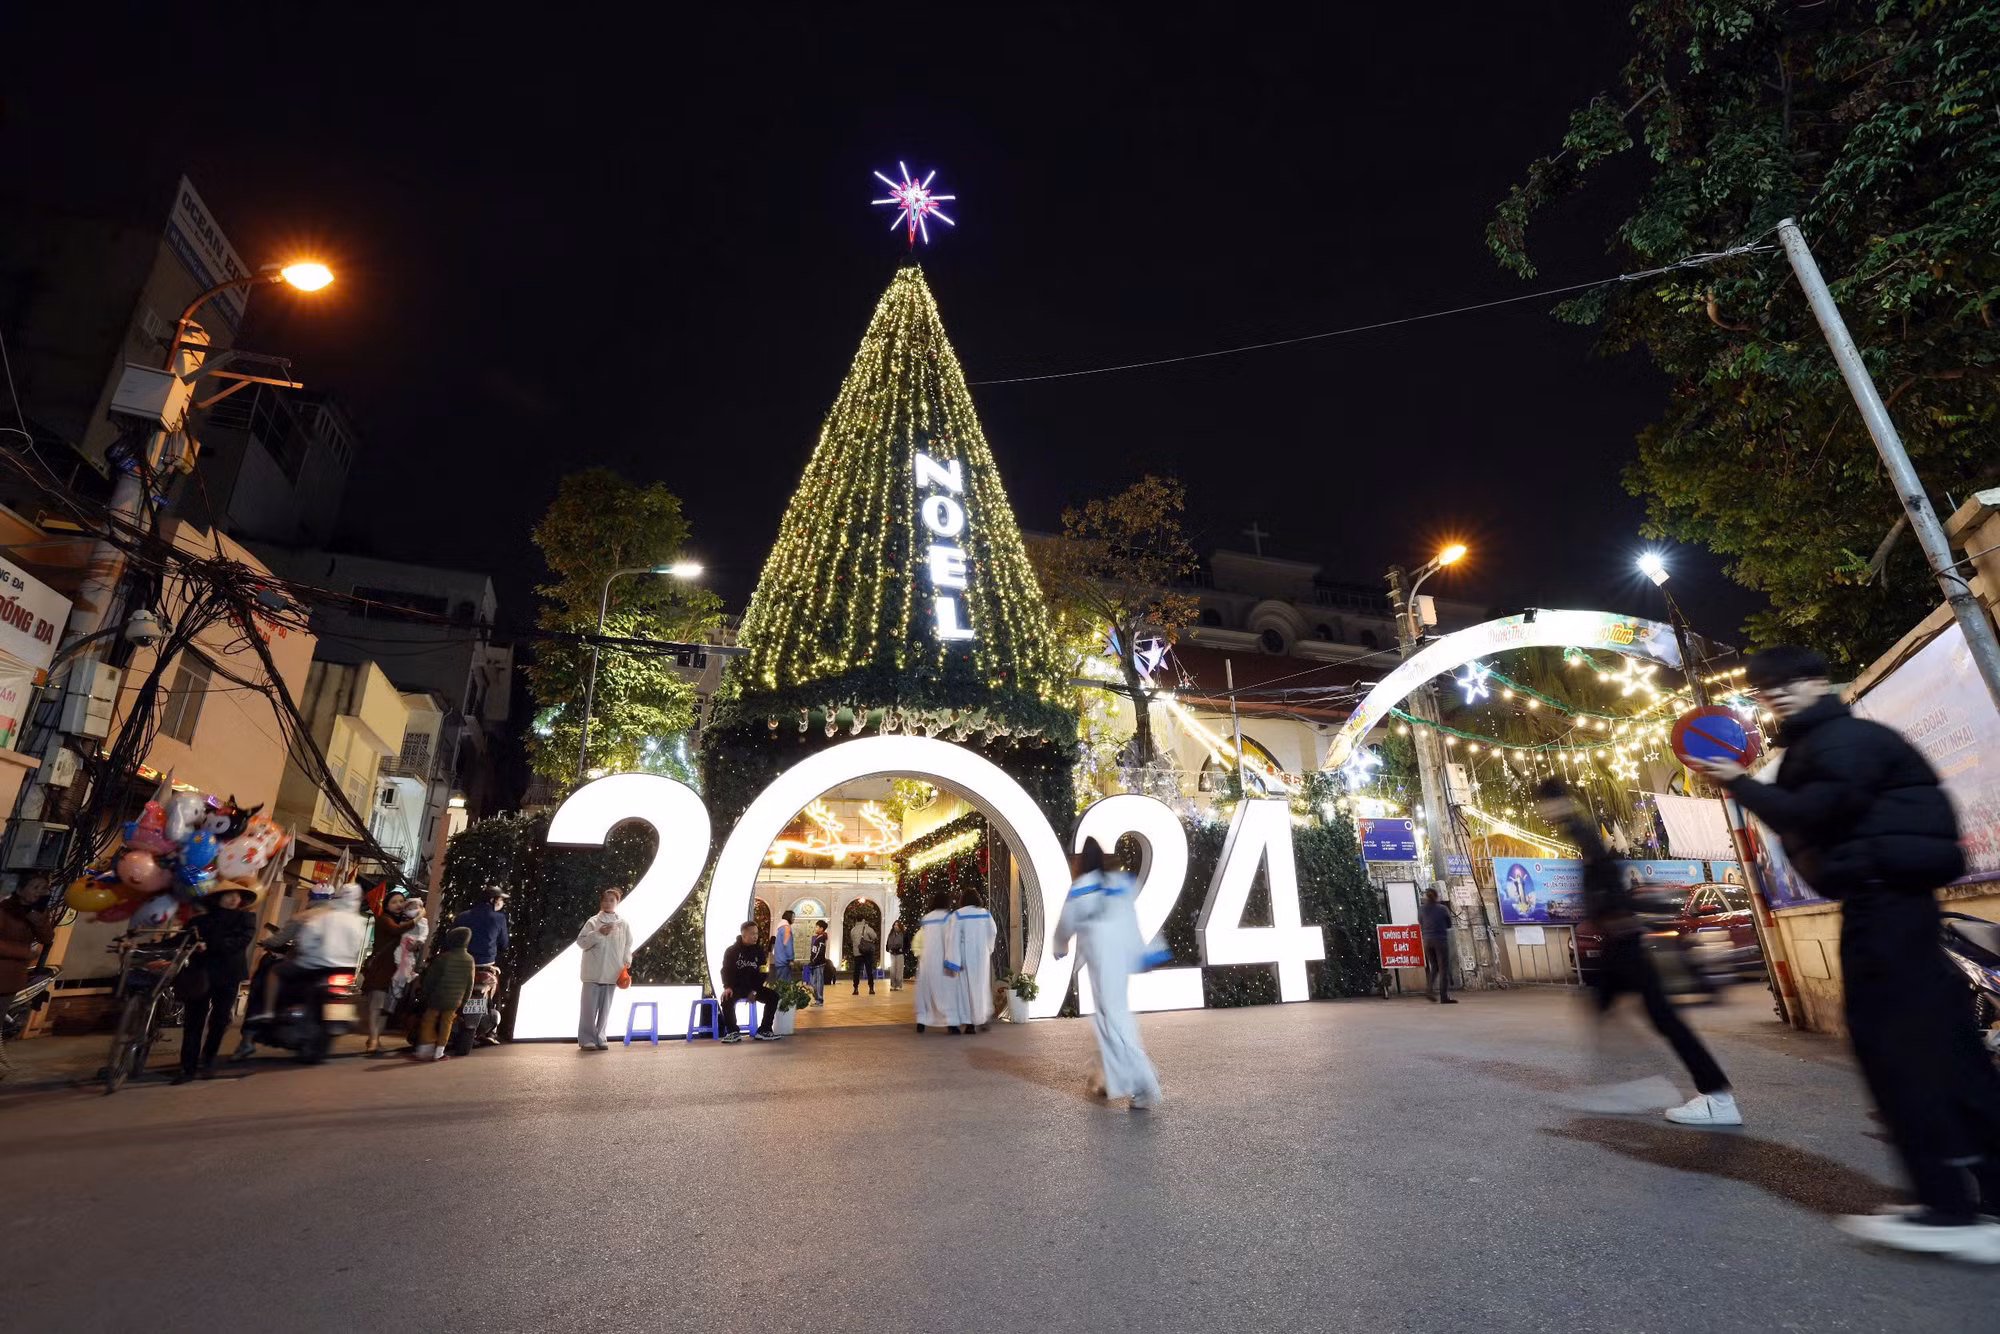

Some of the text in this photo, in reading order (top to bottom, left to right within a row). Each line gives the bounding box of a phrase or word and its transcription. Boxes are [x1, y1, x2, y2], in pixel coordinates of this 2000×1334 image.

[181, 191, 224, 259] OCEAN
[894, 453, 975, 640] NOEL
[12, 577, 24, 591] ĐA
[33, 618, 55, 645] ĐA
[1949, 724, 1974, 750] NHAI
[513, 734, 1325, 1042] 2024
